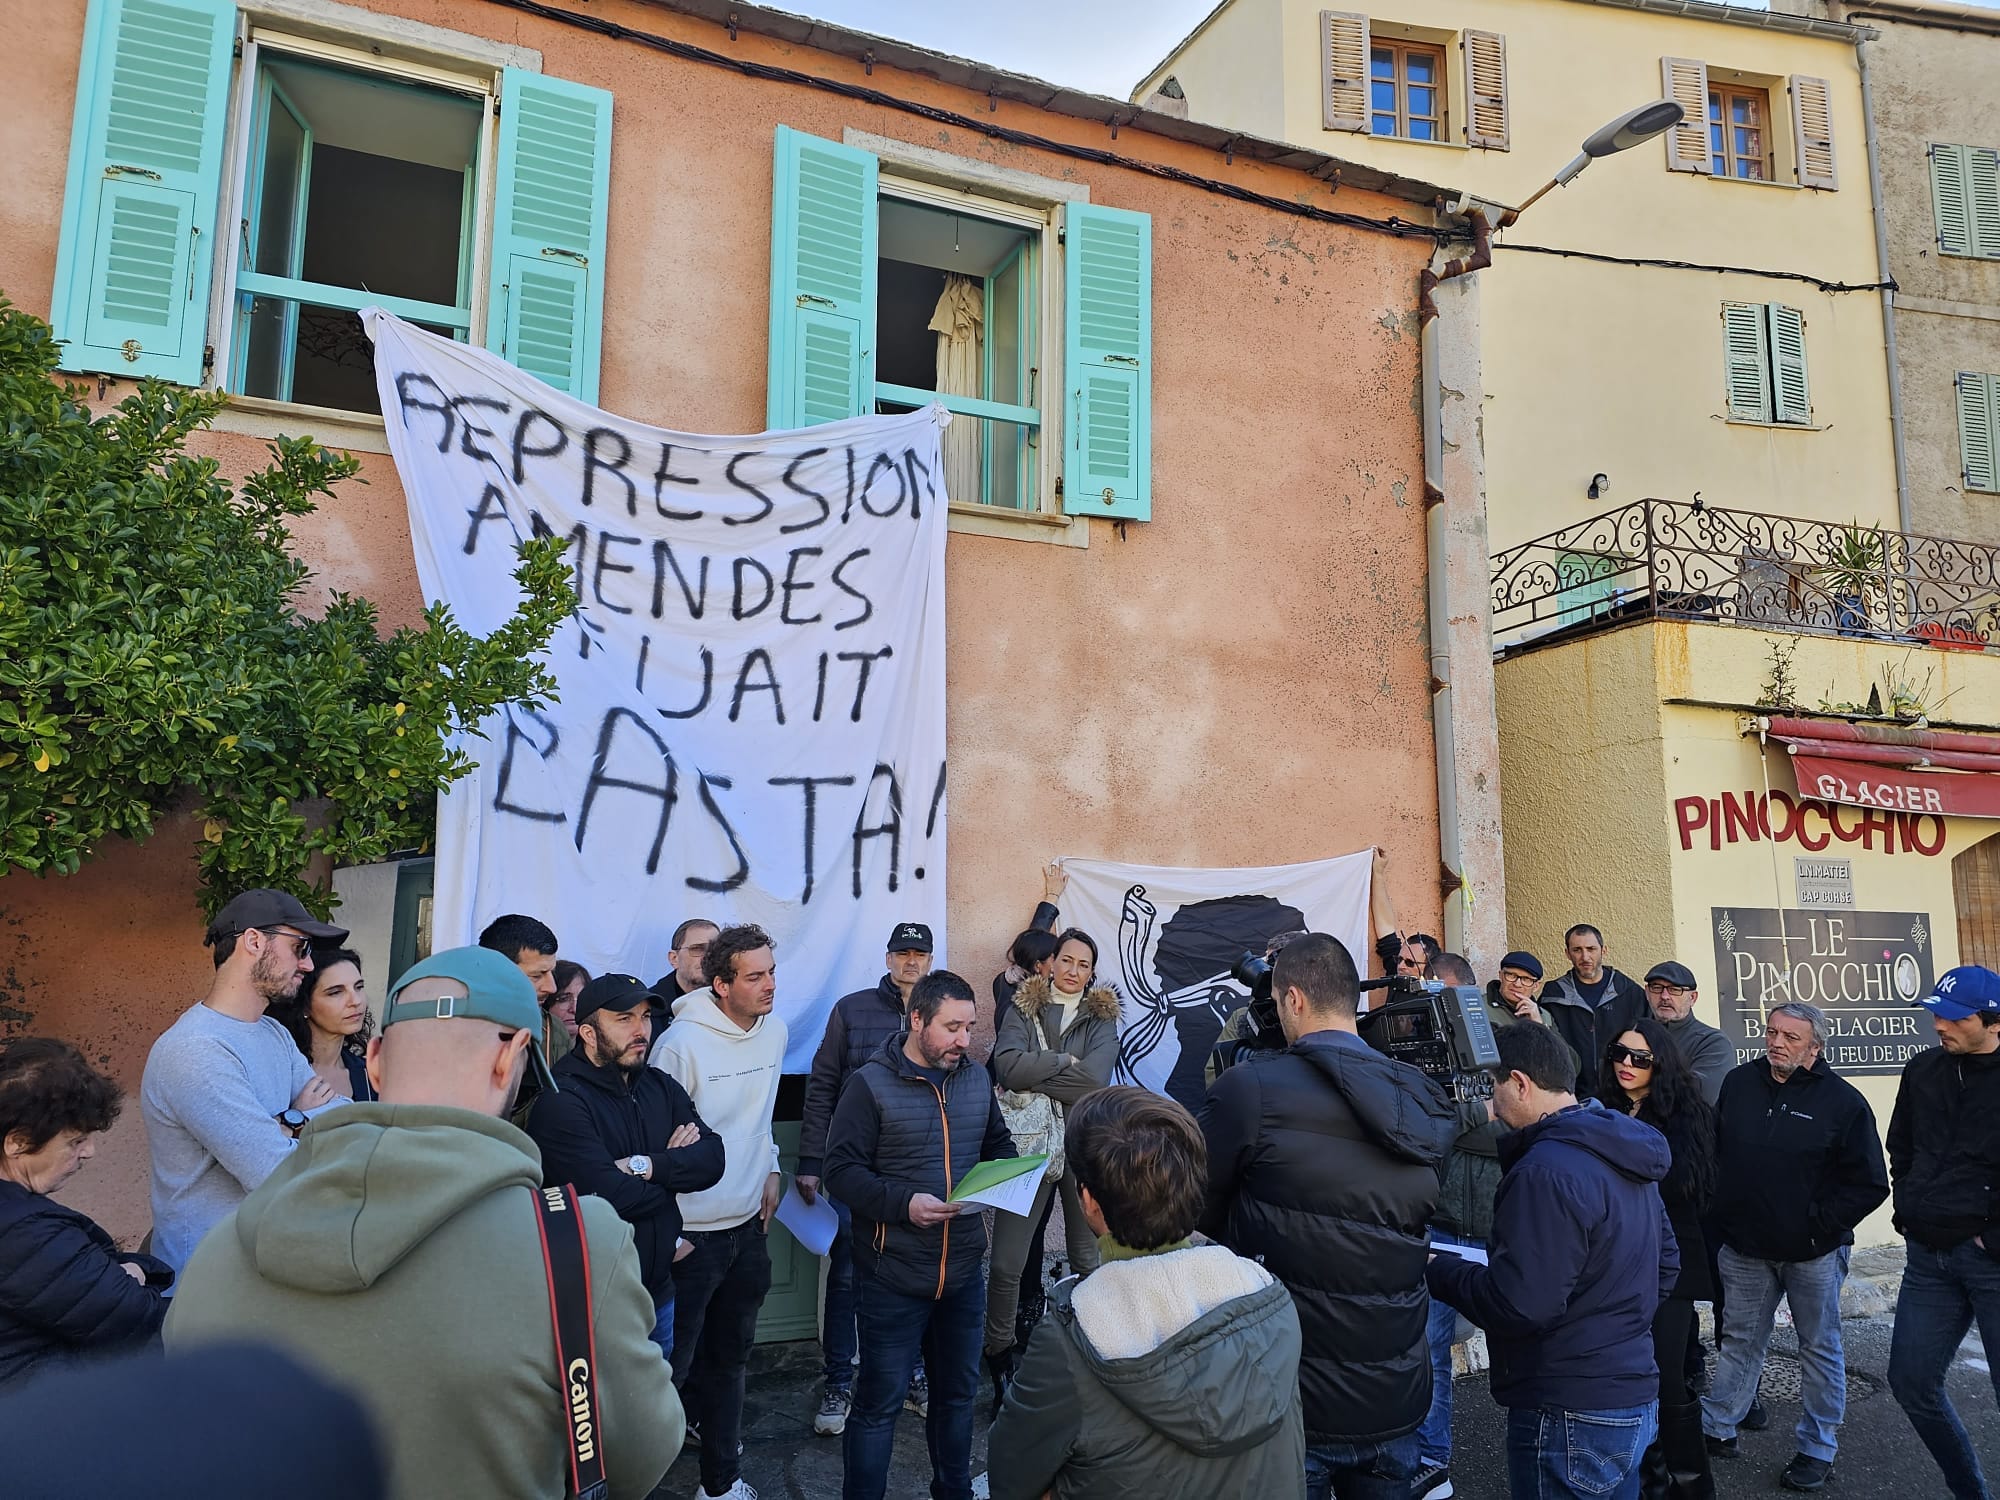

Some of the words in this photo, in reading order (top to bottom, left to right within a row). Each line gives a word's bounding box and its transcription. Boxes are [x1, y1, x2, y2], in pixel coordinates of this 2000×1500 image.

[394, 371, 938, 534] REPRESSION
[463, 482, 873, 631] AMENDES
[494, 697, 946, 905] BASTA!
[1817, 774, 1944, 812] GLACIER
[1675, 788, 1947, 856] PINOCCHIO
[1801, 891, 1820, 903] CAP
[1822, 891, 1852, 904] CORSE
[1807, 918, 1848, 957] LE
[1732, 951, 1922, 1002] PINOCCHIO
[1824, 1016, 1920, 1037] GLACIER
[1839, 1046, 1868, 1063] FEU
[1873, 1045, 1894, 1062] DE
[569, 1358, 594, 1462] Canon
